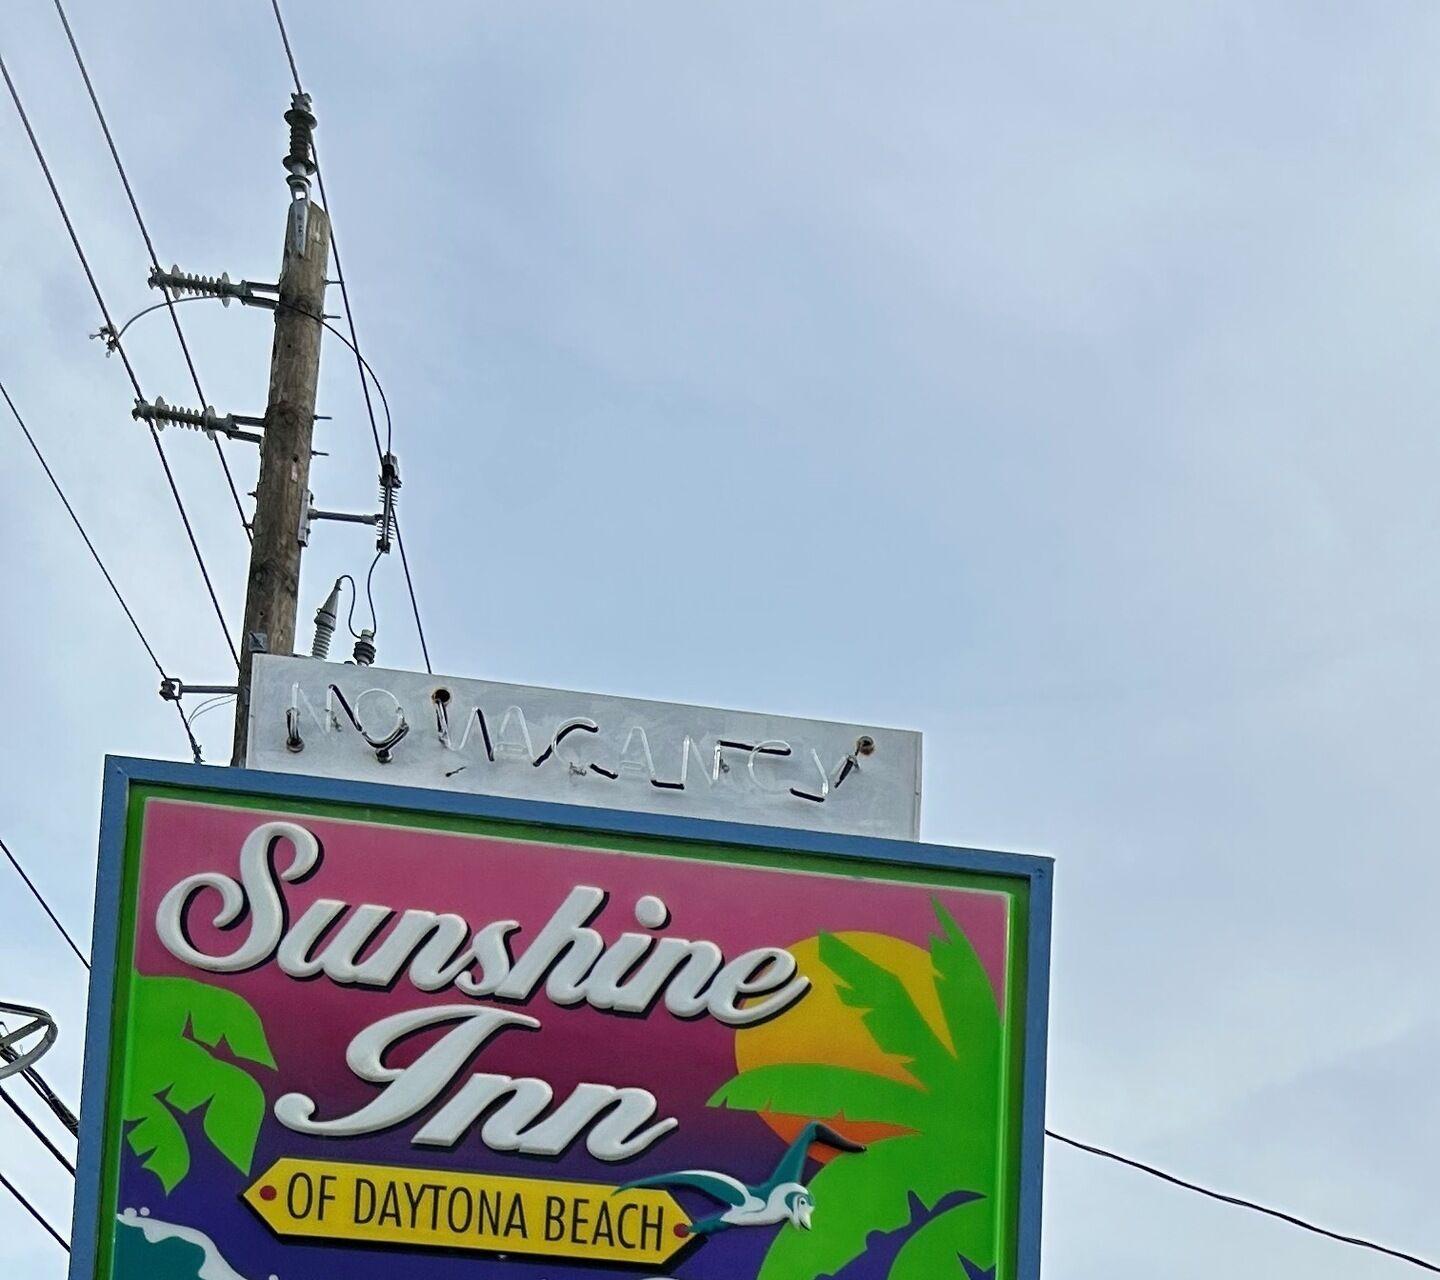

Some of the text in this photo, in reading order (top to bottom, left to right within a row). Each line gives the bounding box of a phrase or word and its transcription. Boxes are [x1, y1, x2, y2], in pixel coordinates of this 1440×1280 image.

[286, 682, 870, 803] NO VACANCY
[155, 821, 809, 1026] Sunshine
[274, 1003, 679, 1163] Inn
[287, 1172, 665, 1252] OF DAYTONA BEACH
